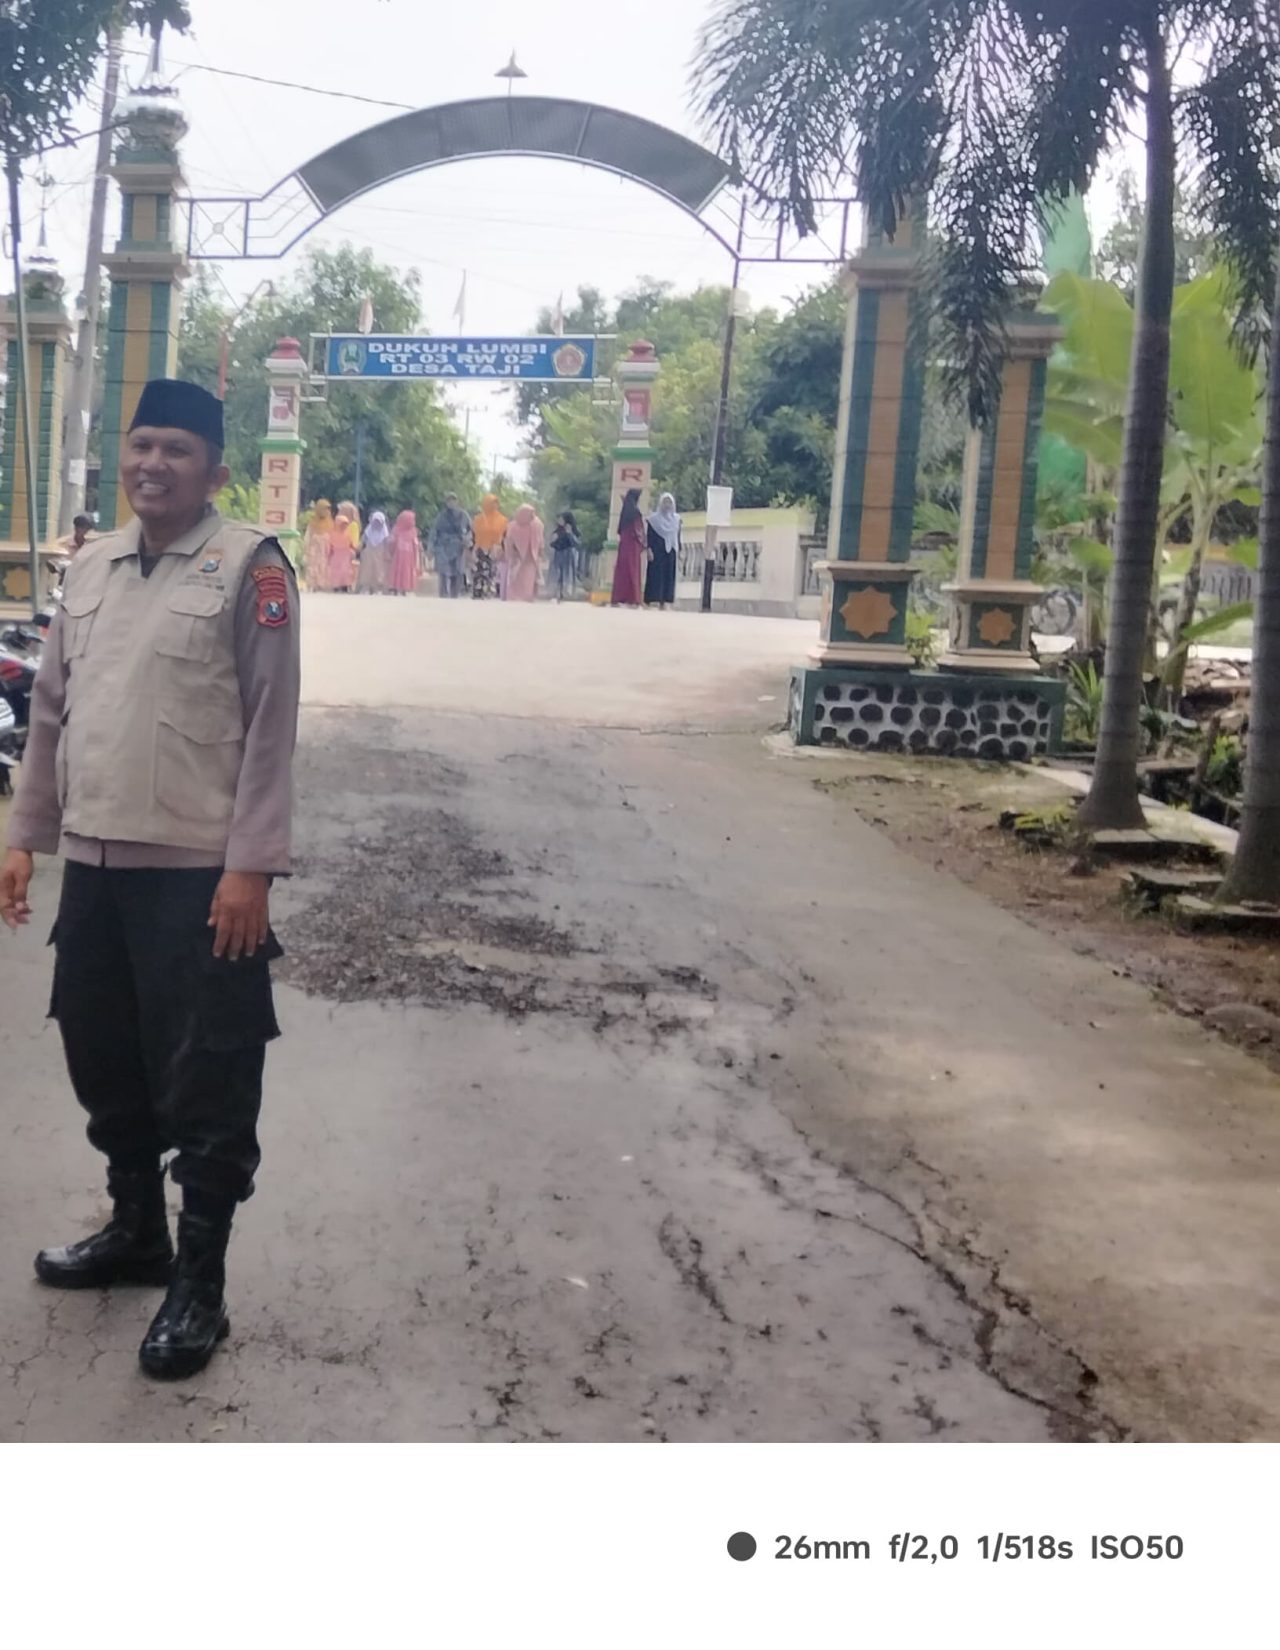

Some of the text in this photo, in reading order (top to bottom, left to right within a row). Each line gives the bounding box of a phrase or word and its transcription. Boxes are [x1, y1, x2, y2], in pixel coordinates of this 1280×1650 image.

[368, 343, 547, 354] DUKUH LUMBI
[380, 354, 534, 364] RT 03 RW 02
[391, 365, 520, 375] DESA TAJI
